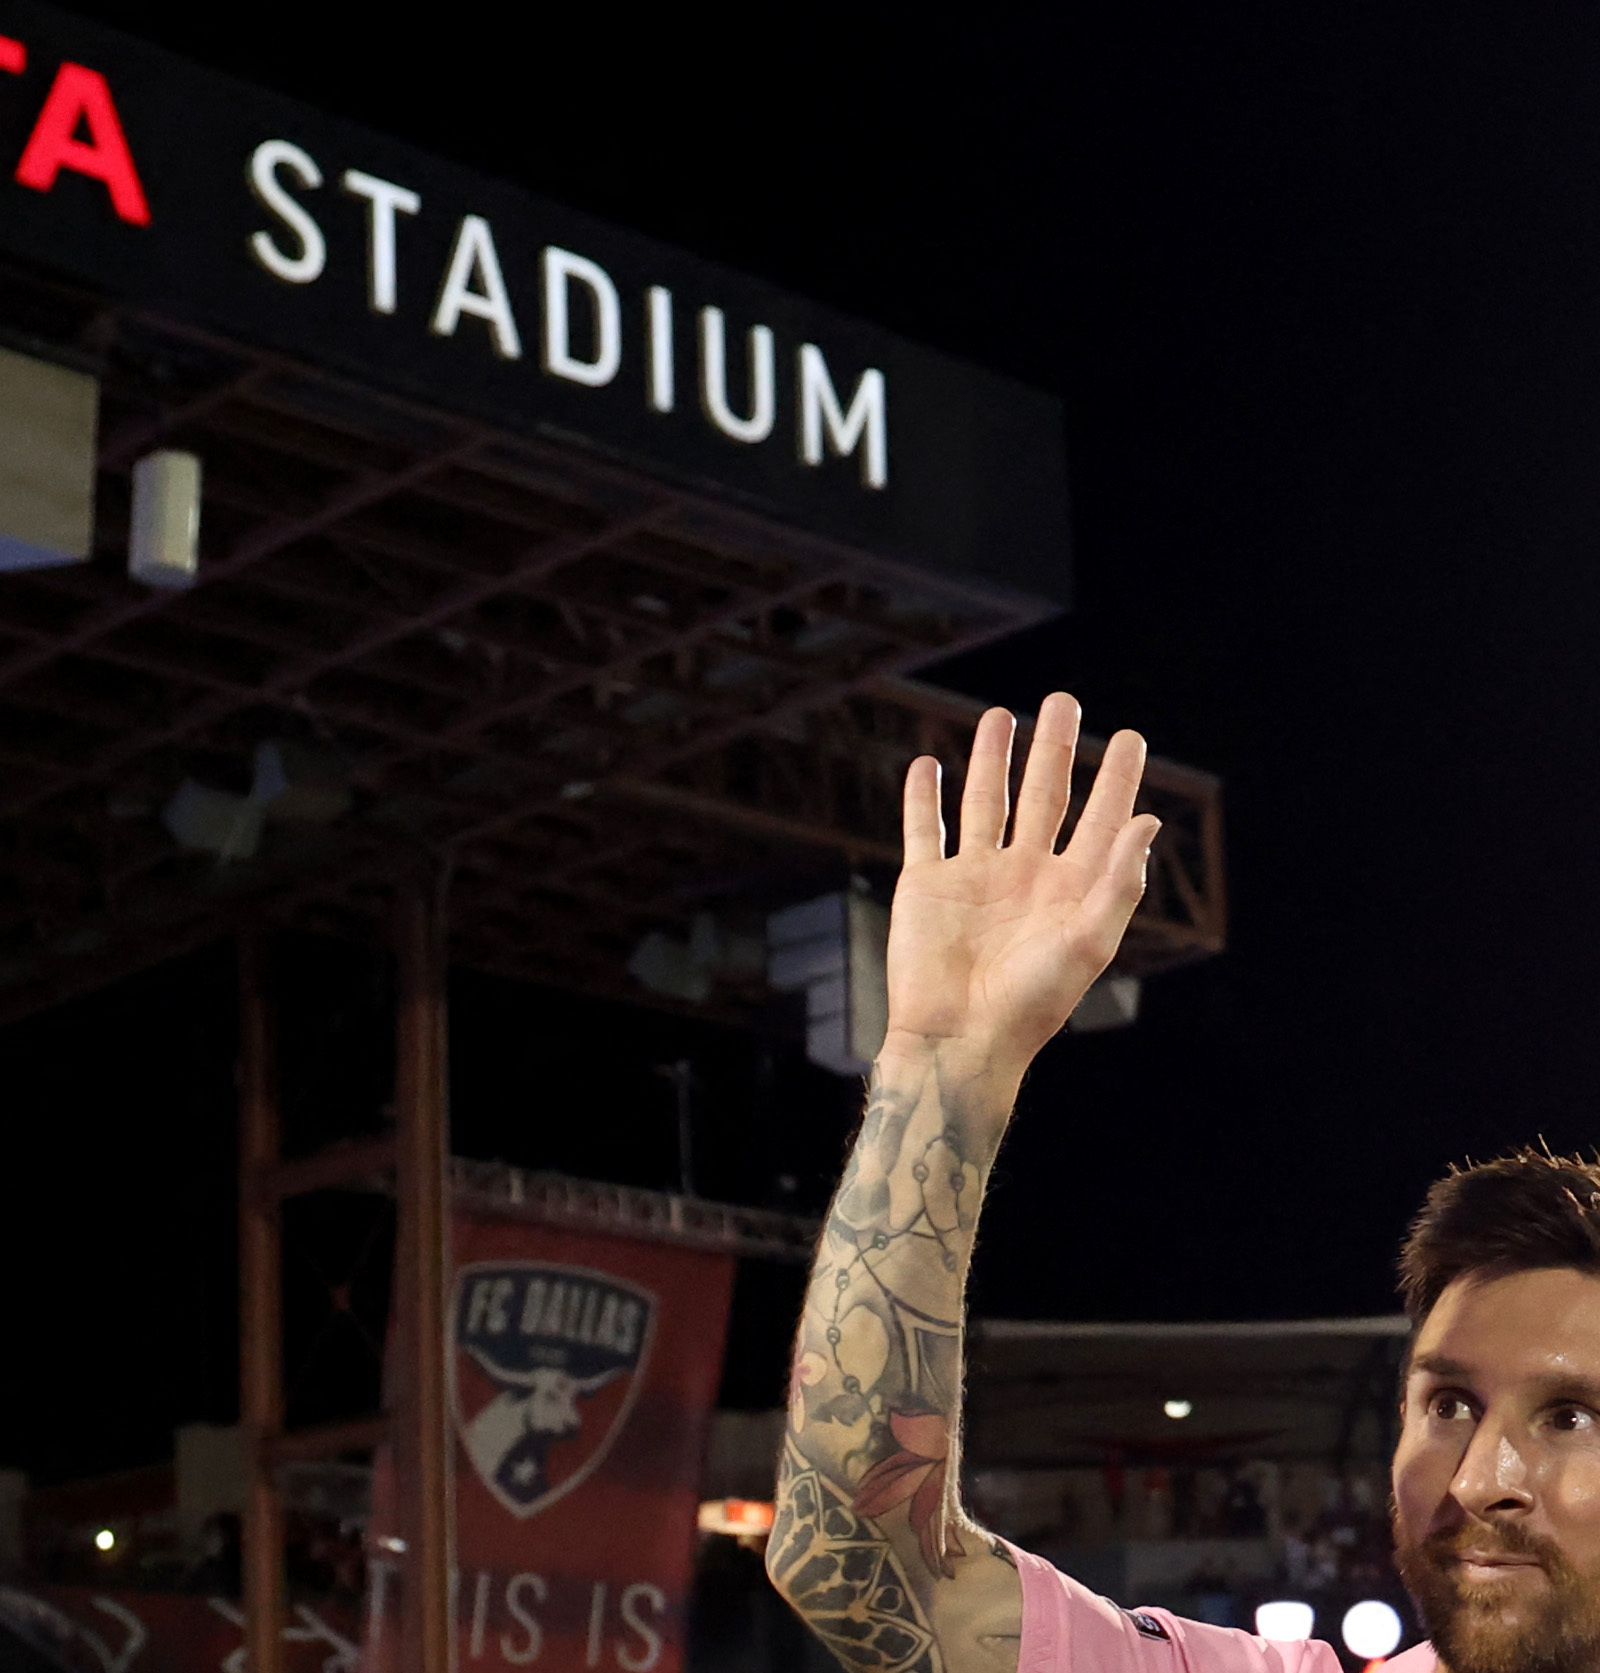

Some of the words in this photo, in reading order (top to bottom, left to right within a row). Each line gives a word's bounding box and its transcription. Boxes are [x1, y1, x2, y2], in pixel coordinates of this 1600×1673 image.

[249, 137, 890, 492] STADIUM
[466, 1276, 514, 1335] FC
[520, 1277, 639, 1354] DALLAS
[368, 1559, 548, 1667] TIS
